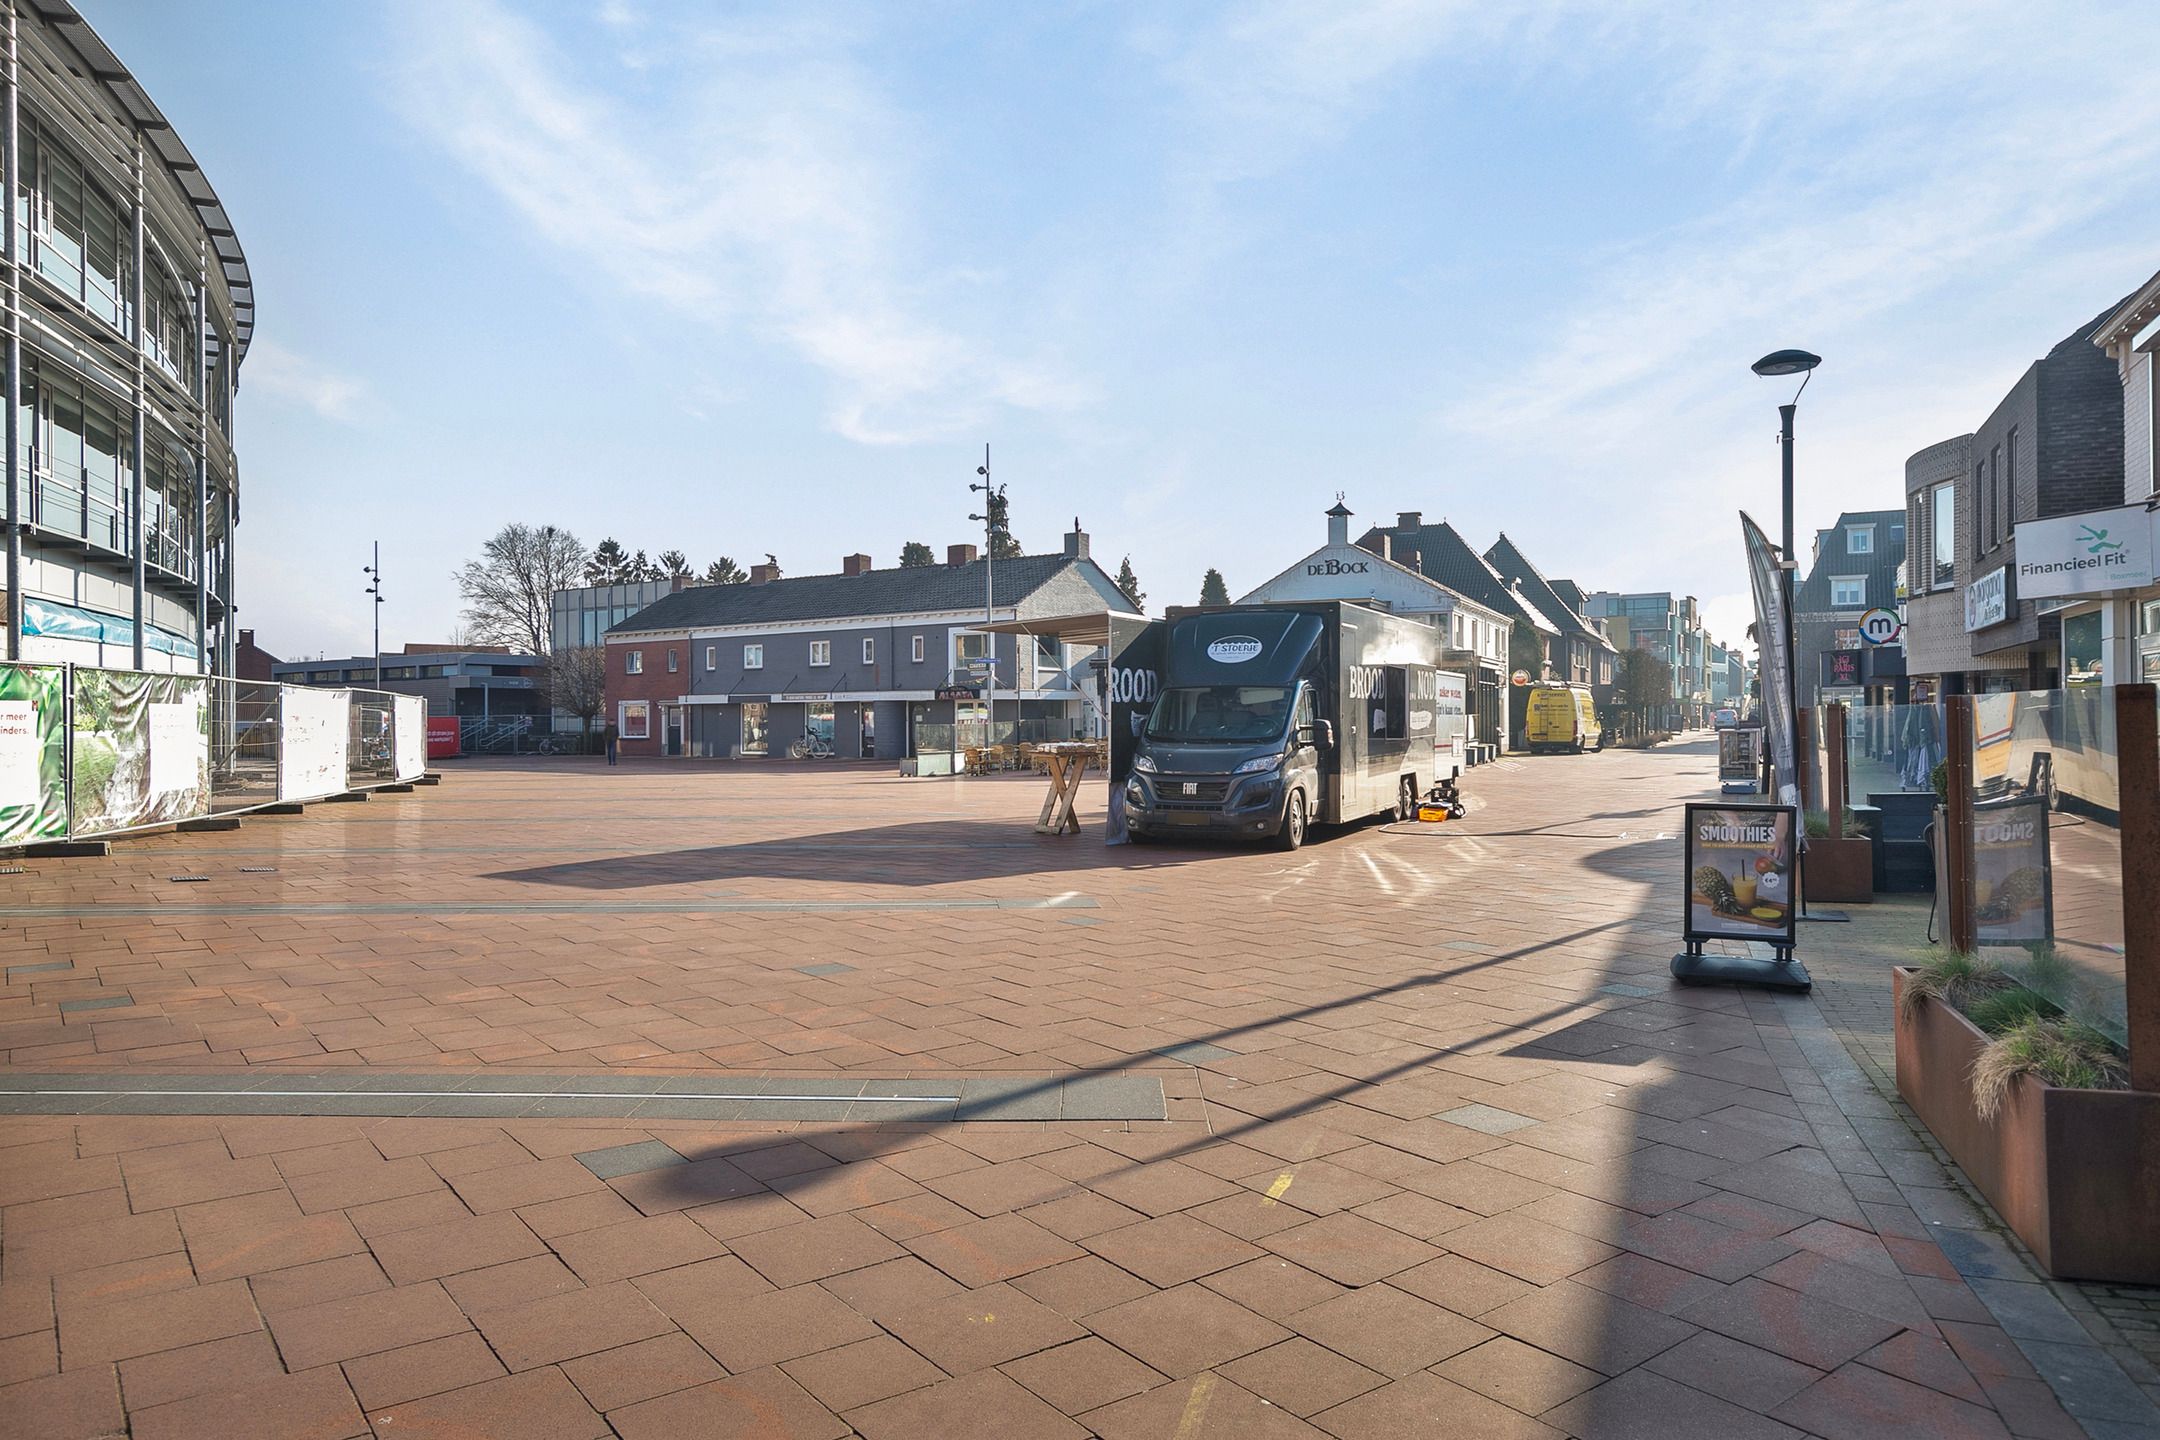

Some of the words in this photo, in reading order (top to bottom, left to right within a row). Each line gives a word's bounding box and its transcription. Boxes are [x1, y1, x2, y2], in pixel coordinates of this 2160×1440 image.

[1307, 564, 1325, 576] DE
[1325, 558, 1369, 576] BOCK
[2021, 555, 2101, 576] Financieel
[1869, 618, 1891, 634] m
[1111, 666, 1158, 703] ROOD
[1349, 665, 1385, 700] BROOD
[6, 713, 27, 721] meer
[0, 726, 30, 735] inders.
[1183, 782, 1198, 795] FIAT
[1699, 824, 1777, 843] SMOOTHIES
